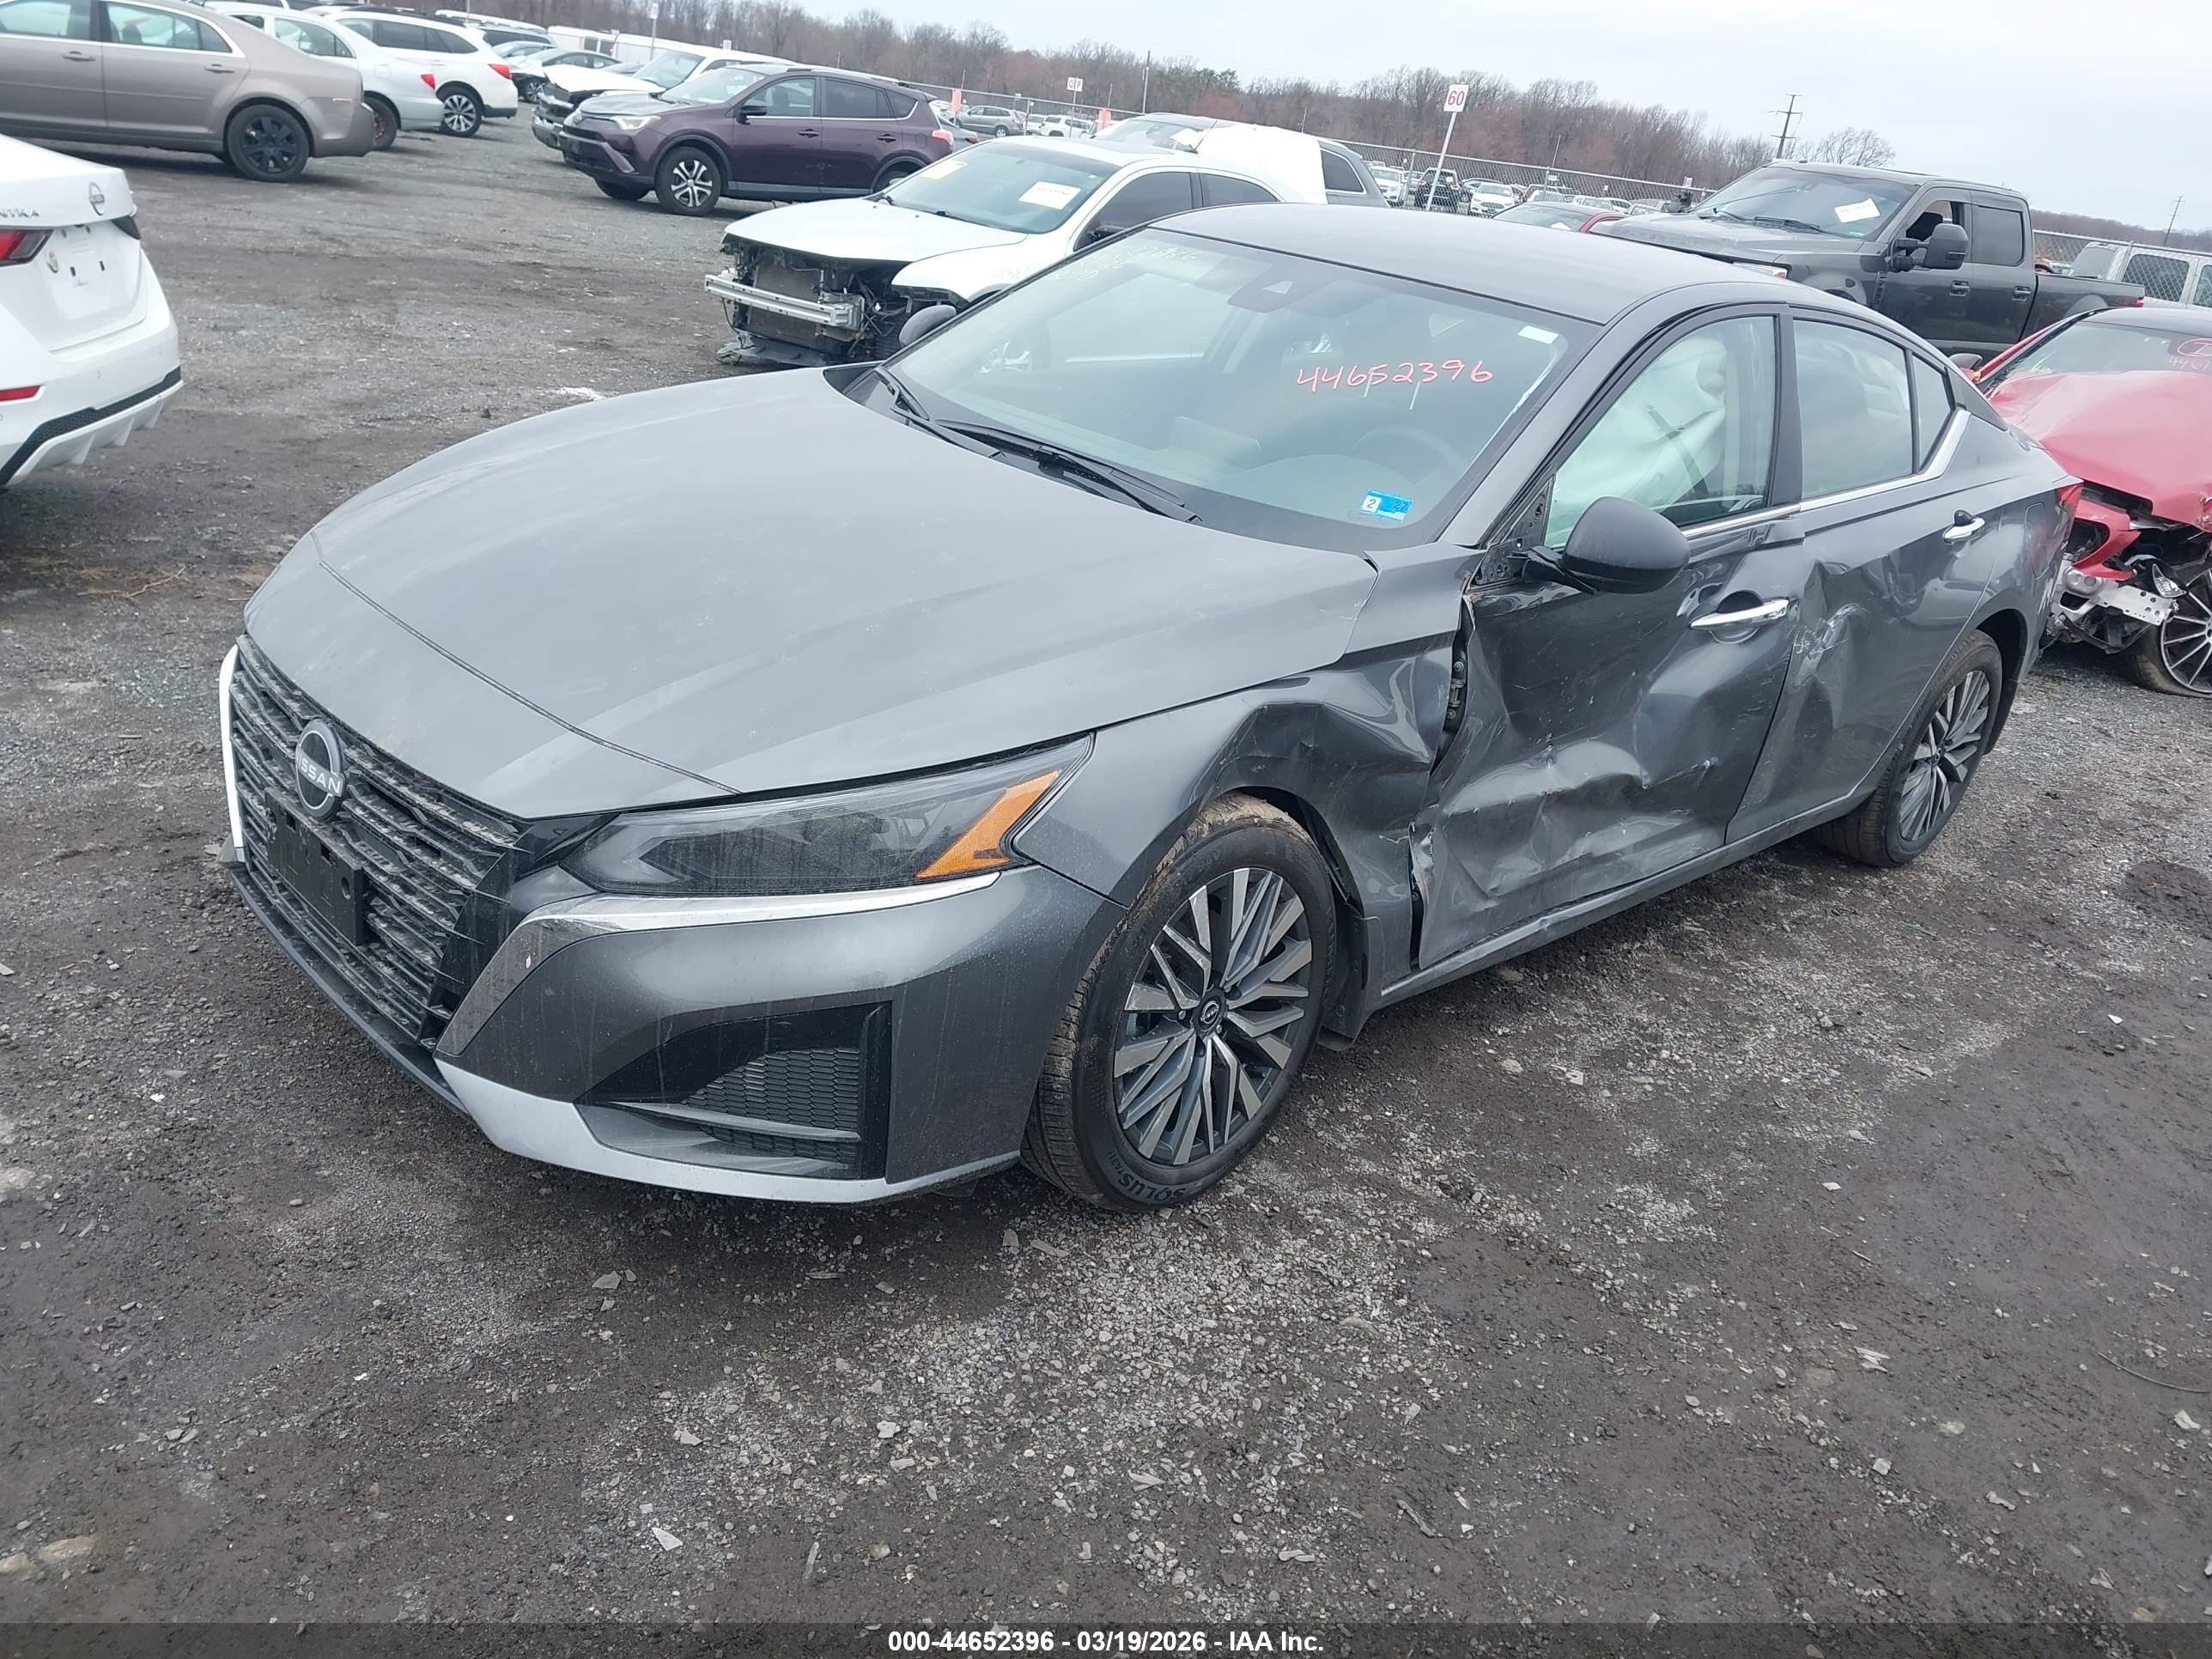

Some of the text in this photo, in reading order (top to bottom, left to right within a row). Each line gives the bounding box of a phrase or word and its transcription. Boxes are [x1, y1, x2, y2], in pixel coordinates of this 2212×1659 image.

[1448, 90, 1465, 106] 60
[1297, 359, 1494, 392] 44652396
[1366, 498, 1377, 509] 2
[296, 749, 342, 794] ISSAN
[1119, 1173, 1187, 1201] SOLUS
